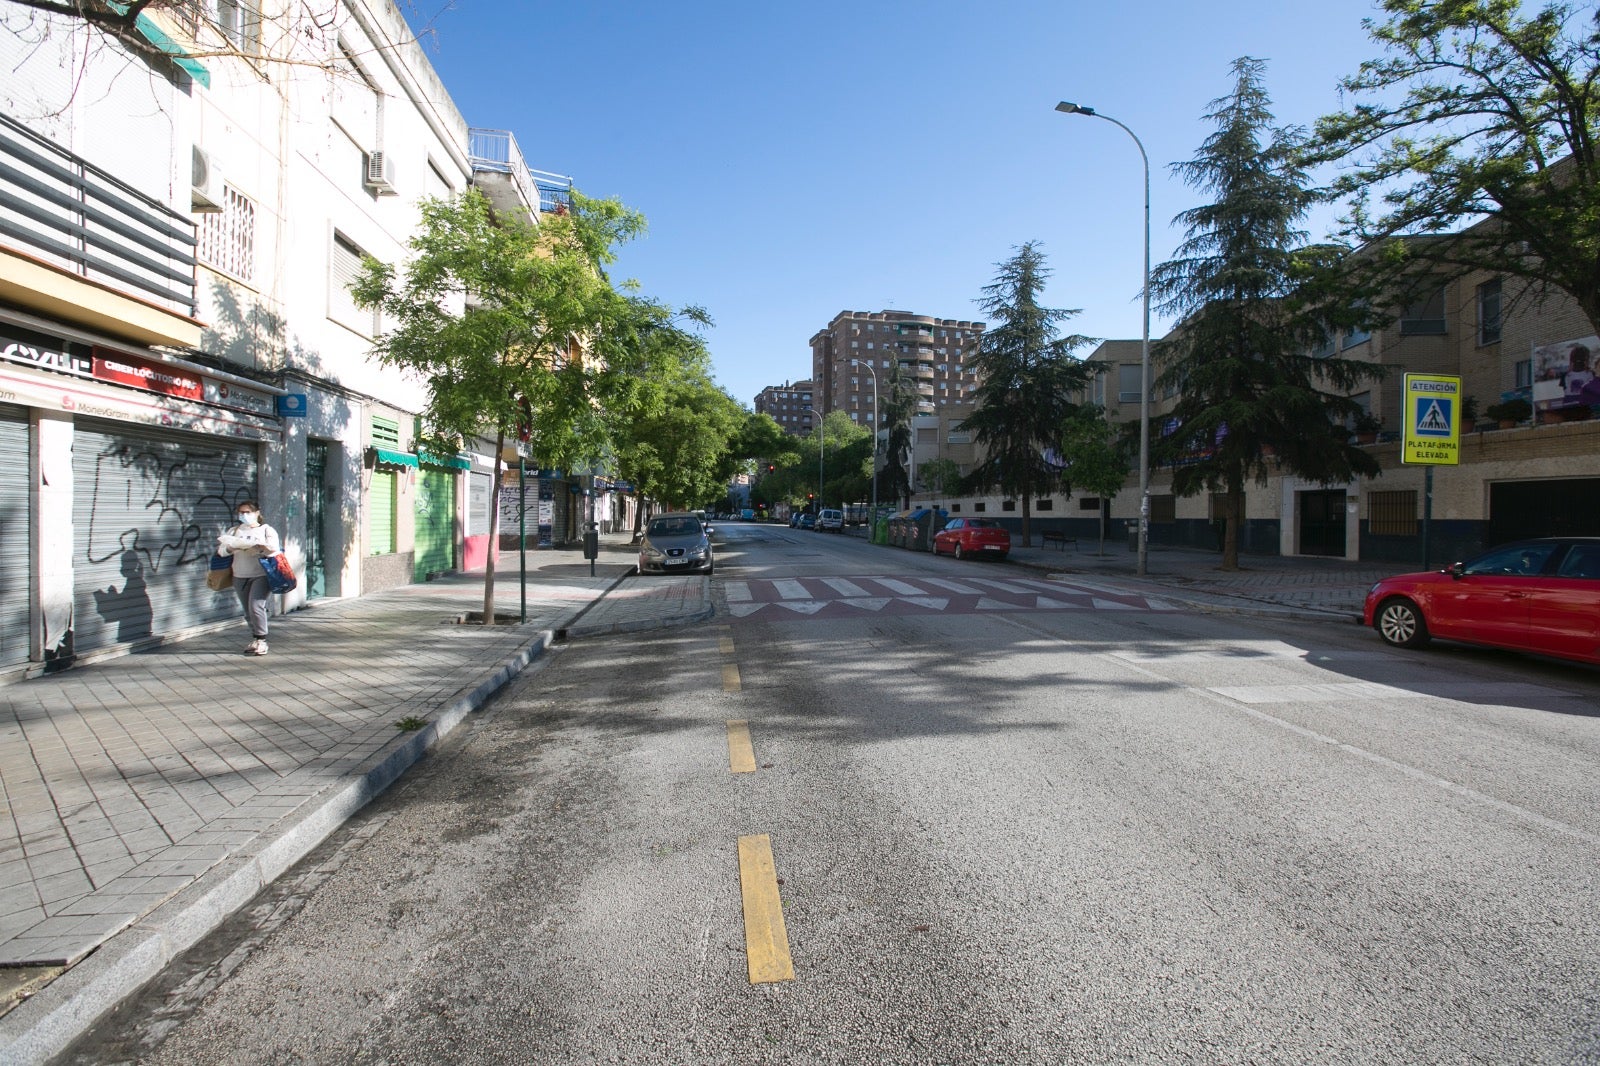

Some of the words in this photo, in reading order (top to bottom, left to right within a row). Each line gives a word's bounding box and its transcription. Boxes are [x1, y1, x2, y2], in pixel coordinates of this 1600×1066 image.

[105, 360, 133, 375] CIBER
[134, 368, 182, 387] LOCUTORIO
[1412, 382, 1456, 392] ATENCIÓN
[78, 403, 130, 420] MoneyGram
[1408, 441, 1457, 450] PLATAFORMA
[1416, 451, 1449, 459] ELEVADA
